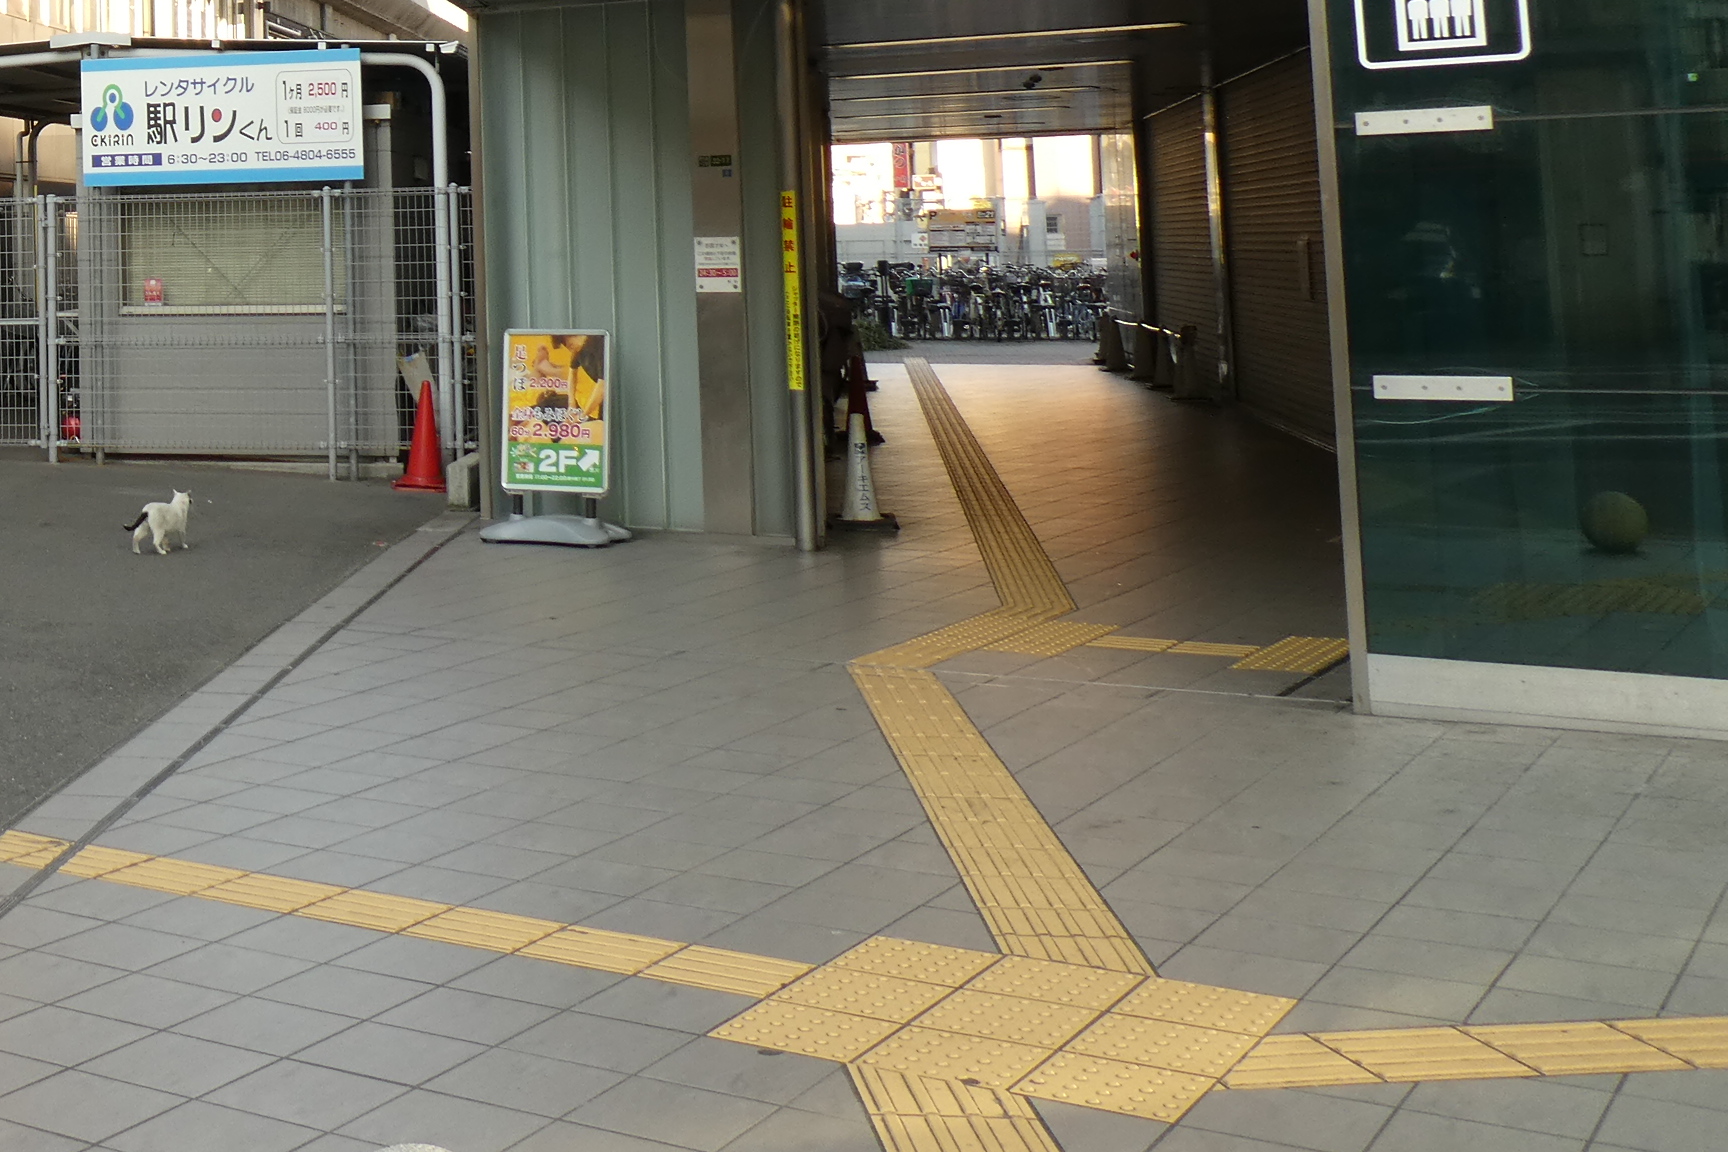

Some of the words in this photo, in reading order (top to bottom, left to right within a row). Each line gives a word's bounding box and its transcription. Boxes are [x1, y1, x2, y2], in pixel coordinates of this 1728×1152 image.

[144, 76, 255, 97] レンタサイクル
[146, 101, 273, 145] 駅リンくん
[100, 155, 154, 167] 営業時間
[254, 147, 356, 162] TEL06-4804-6555
[538, 448, 579, 473] 2F
